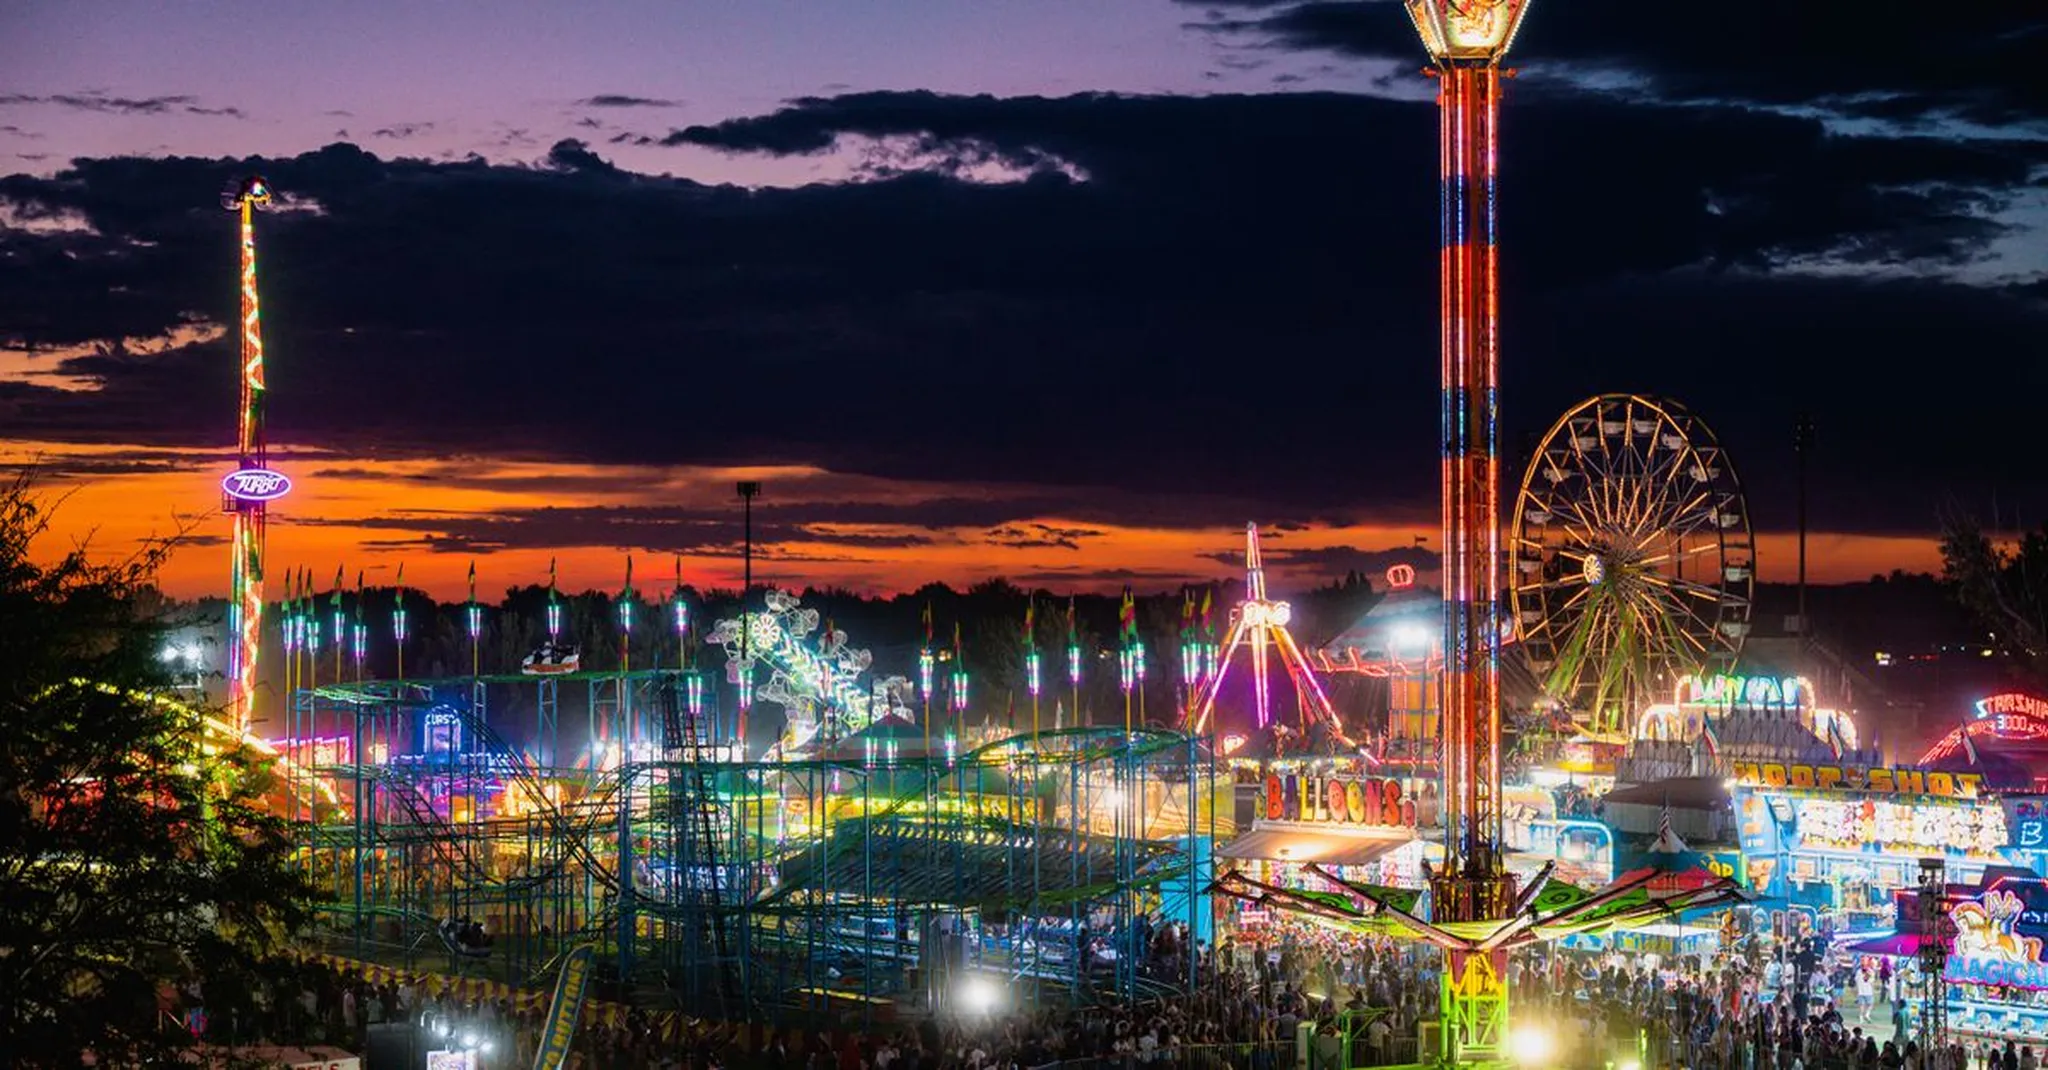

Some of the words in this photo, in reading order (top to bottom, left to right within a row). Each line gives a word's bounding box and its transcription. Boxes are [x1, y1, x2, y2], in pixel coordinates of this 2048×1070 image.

[234, 475, 281, 494] TURBO
[1975, 694, 2048, 720] STARSHIP
[1997, 714, 2028, 732] 3000
[1868, 768, 1982, 799] SHOT
[1267, 773, 1401, 827] BALLOONS
